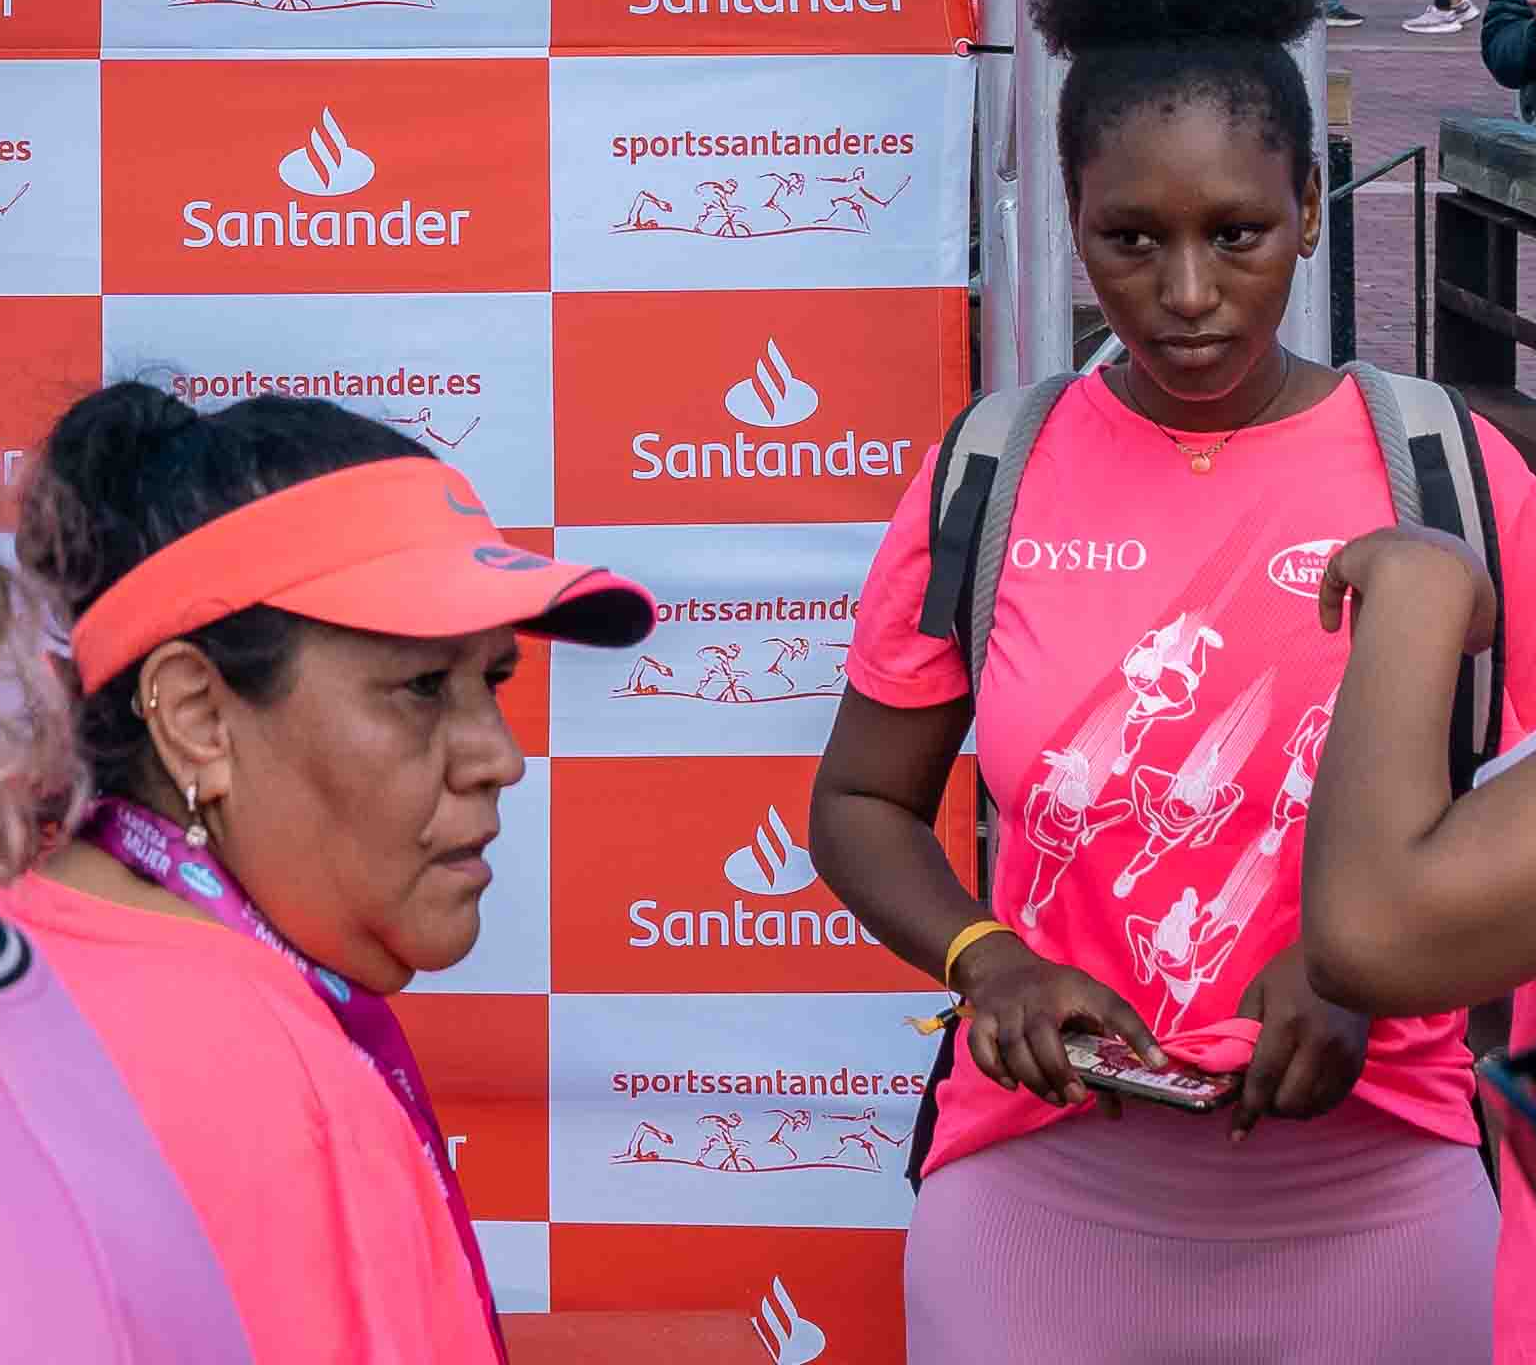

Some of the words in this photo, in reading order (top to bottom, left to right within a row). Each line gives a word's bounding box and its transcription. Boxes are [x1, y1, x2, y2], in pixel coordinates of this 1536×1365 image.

[612, 127, 914, 163] sportssantander.es
[183, 200, 471, 248] Santander
[172, 367, 482, 402] sportssantander.es
[632, 430, 911, 480] Santander
[1009, 536, 1149, 573] OYSHO
[612, 1067, 925, 1101] sportssantander.es
